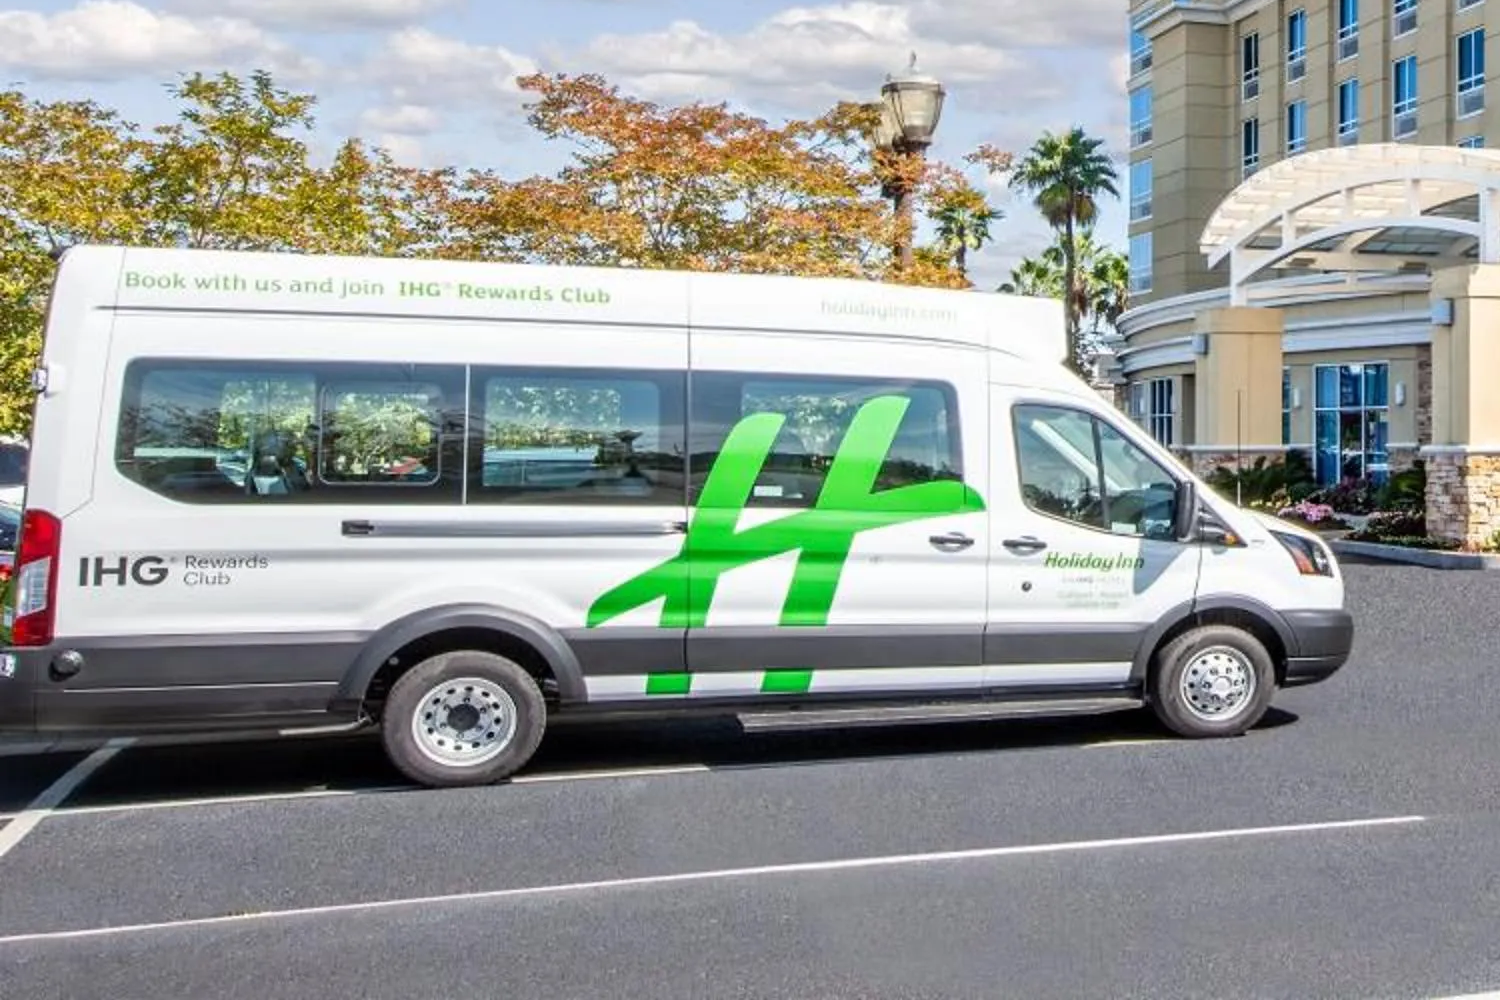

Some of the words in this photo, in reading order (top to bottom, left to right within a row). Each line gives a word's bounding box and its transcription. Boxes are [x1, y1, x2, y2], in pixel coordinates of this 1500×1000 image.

[125, 271, 186, 290] Book
[194, 273, 247, 292] with
[255, 278, 283, 292] us
[289, 277, 334, 295] and
[341, 278, 385, 299] join
[458, 283, 554, 302] Rewards
[561, 286, 612, 304] Club
[79, 555, 169, 587] IHG
[184, 554, 269, 570] Rewards
[1044, 551, 1115, 572] Holiday
[1115, 551, 1145, 569] Inn
[183, 571, 233, 587] Club
